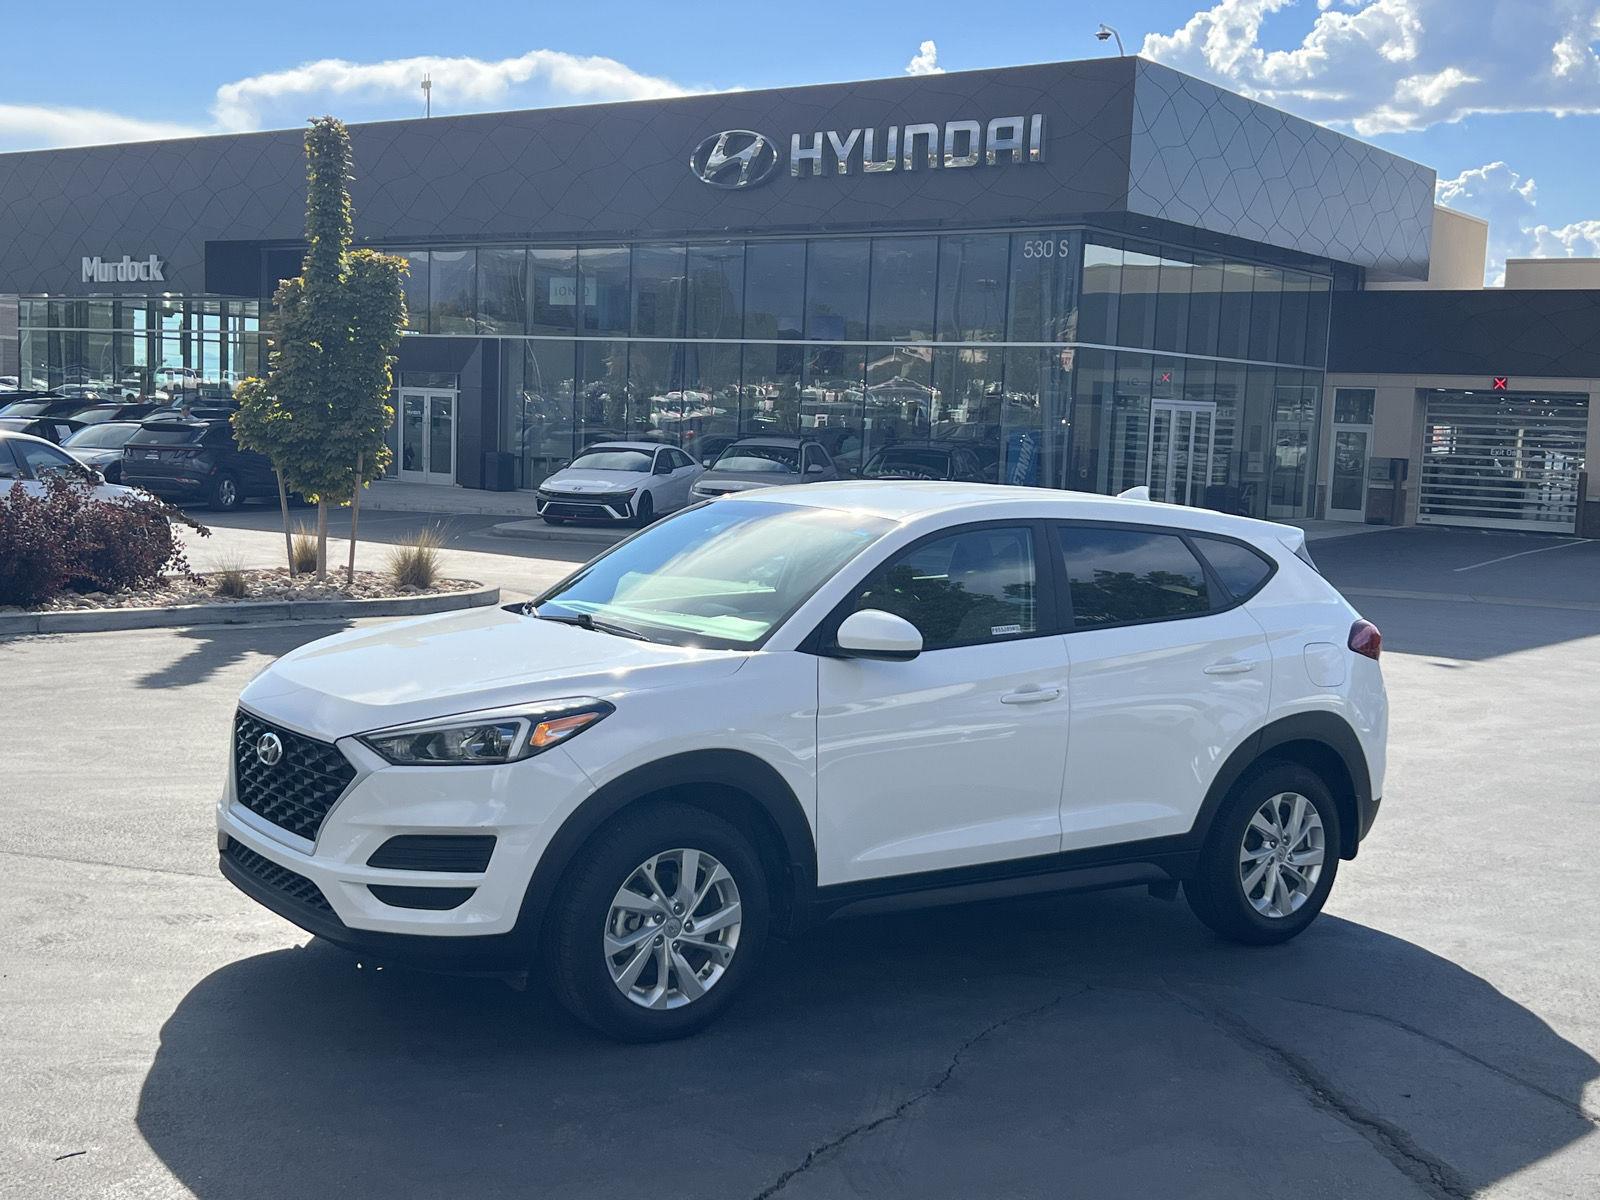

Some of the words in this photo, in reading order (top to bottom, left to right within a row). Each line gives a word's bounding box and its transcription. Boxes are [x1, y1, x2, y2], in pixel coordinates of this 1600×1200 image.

[790, 113, 1043, 177] HYUNDAI
[1023, 240, 1054, 259] 530
[1058, 239, 1069, 258] S
[81, 254, 165, 283] Murdock
